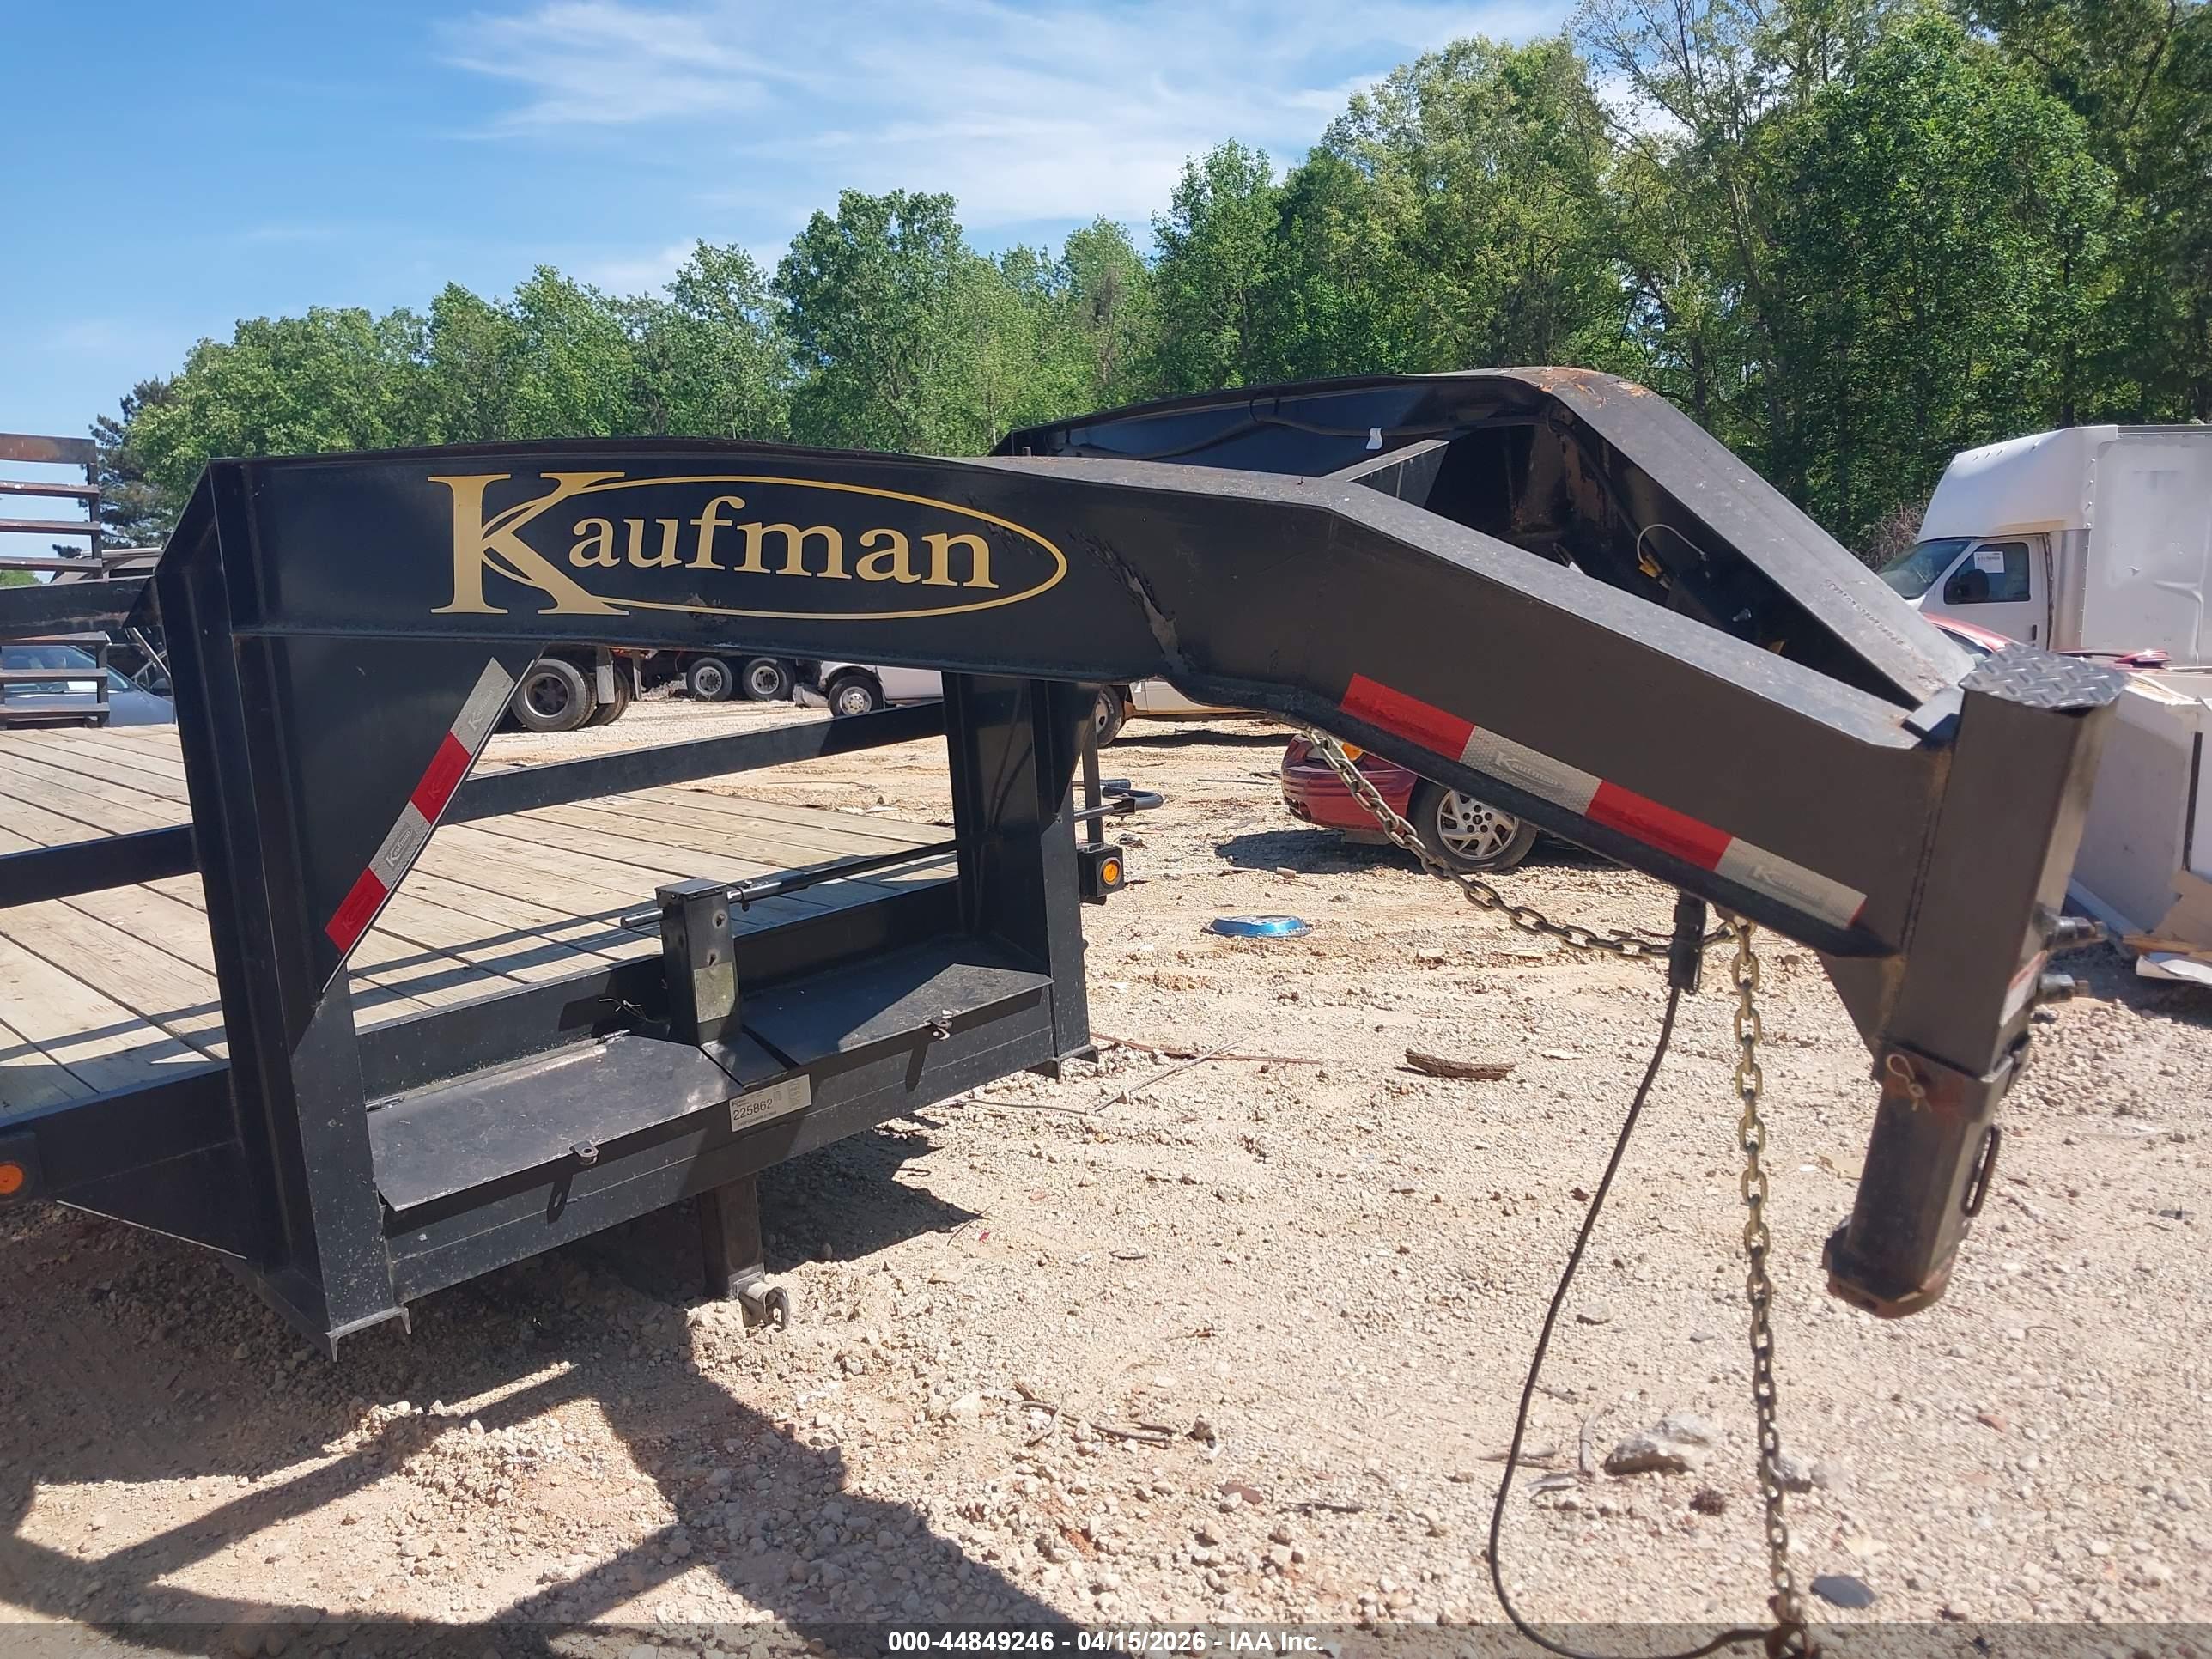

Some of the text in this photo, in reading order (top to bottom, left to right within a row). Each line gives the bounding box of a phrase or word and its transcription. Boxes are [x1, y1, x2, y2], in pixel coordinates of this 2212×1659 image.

[428, 471, 1000, 616] Kaufman
[1492, 751, 1560, 786] Kaufman
[386, 830, 412, 869] Kaufman
[732, 1098, 773, 1121] 225862
